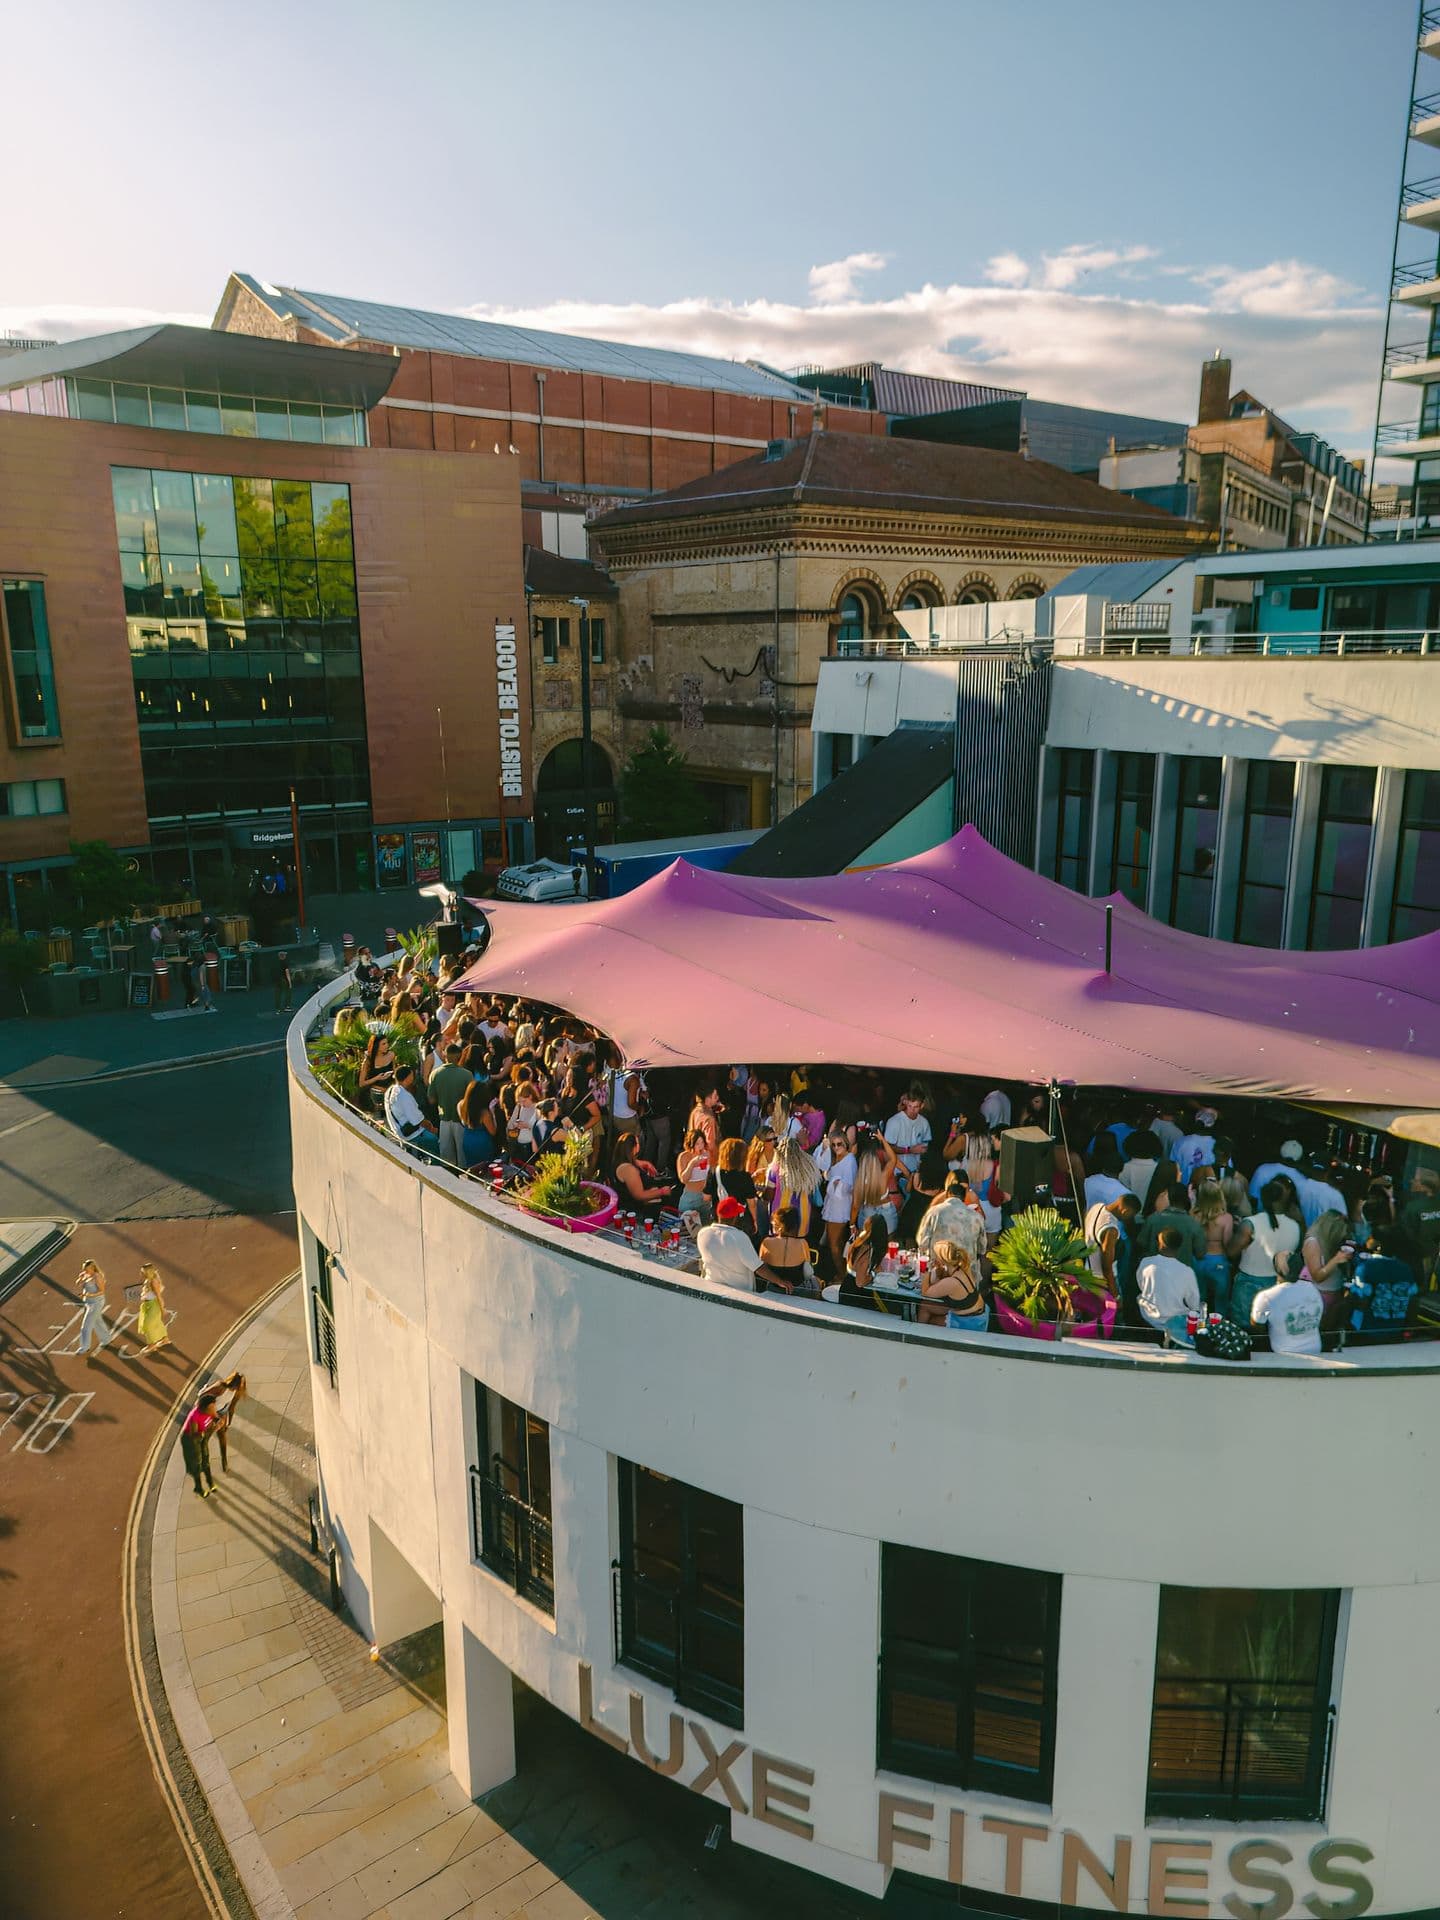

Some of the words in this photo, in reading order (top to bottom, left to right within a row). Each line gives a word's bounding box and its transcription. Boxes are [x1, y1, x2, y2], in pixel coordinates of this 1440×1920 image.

[495, 624, 518, 709] BEACON
[499, 712, 522, 797] BRISTOL
[253, 832, 294, 843] Bridgeho
[0, 1391, 96, 1454] BU
[578, 1661, 815, 1841] LUXE
[878, 1792, 1375, 1919] FITNESS
